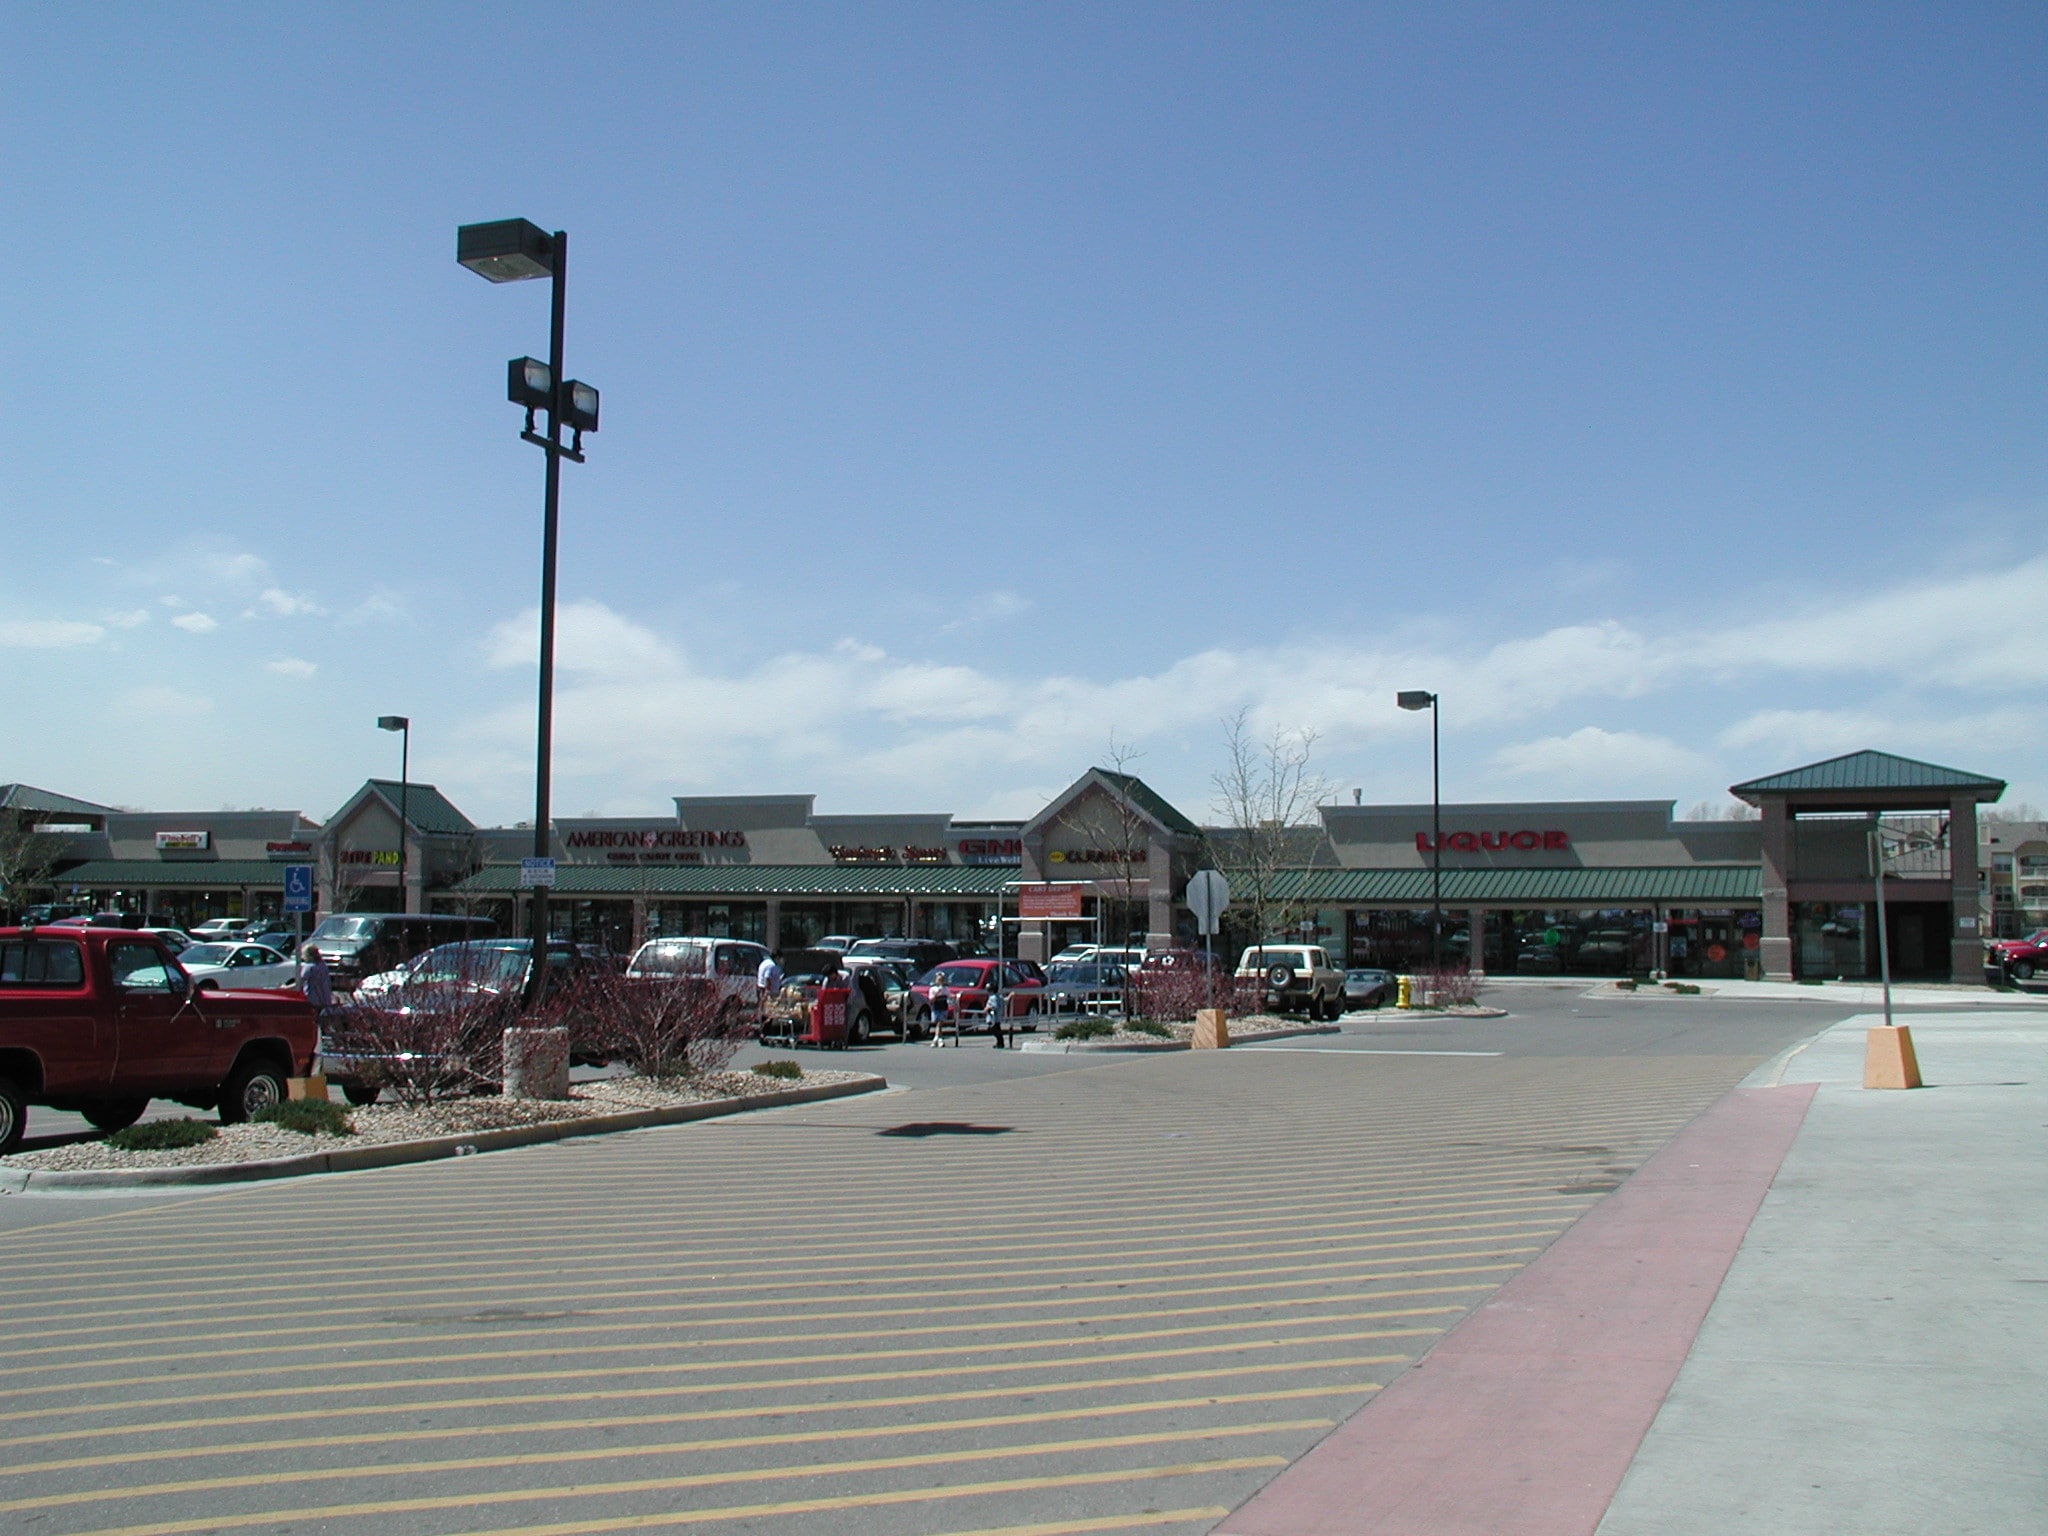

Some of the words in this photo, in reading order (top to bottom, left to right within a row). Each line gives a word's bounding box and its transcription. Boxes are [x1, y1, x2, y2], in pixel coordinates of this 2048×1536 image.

[566, 831, 645, 848] AMERICAN
[657, 830, 745, 848] GREETINGS
[1415, 830, 1569, 852] LIQUOR
